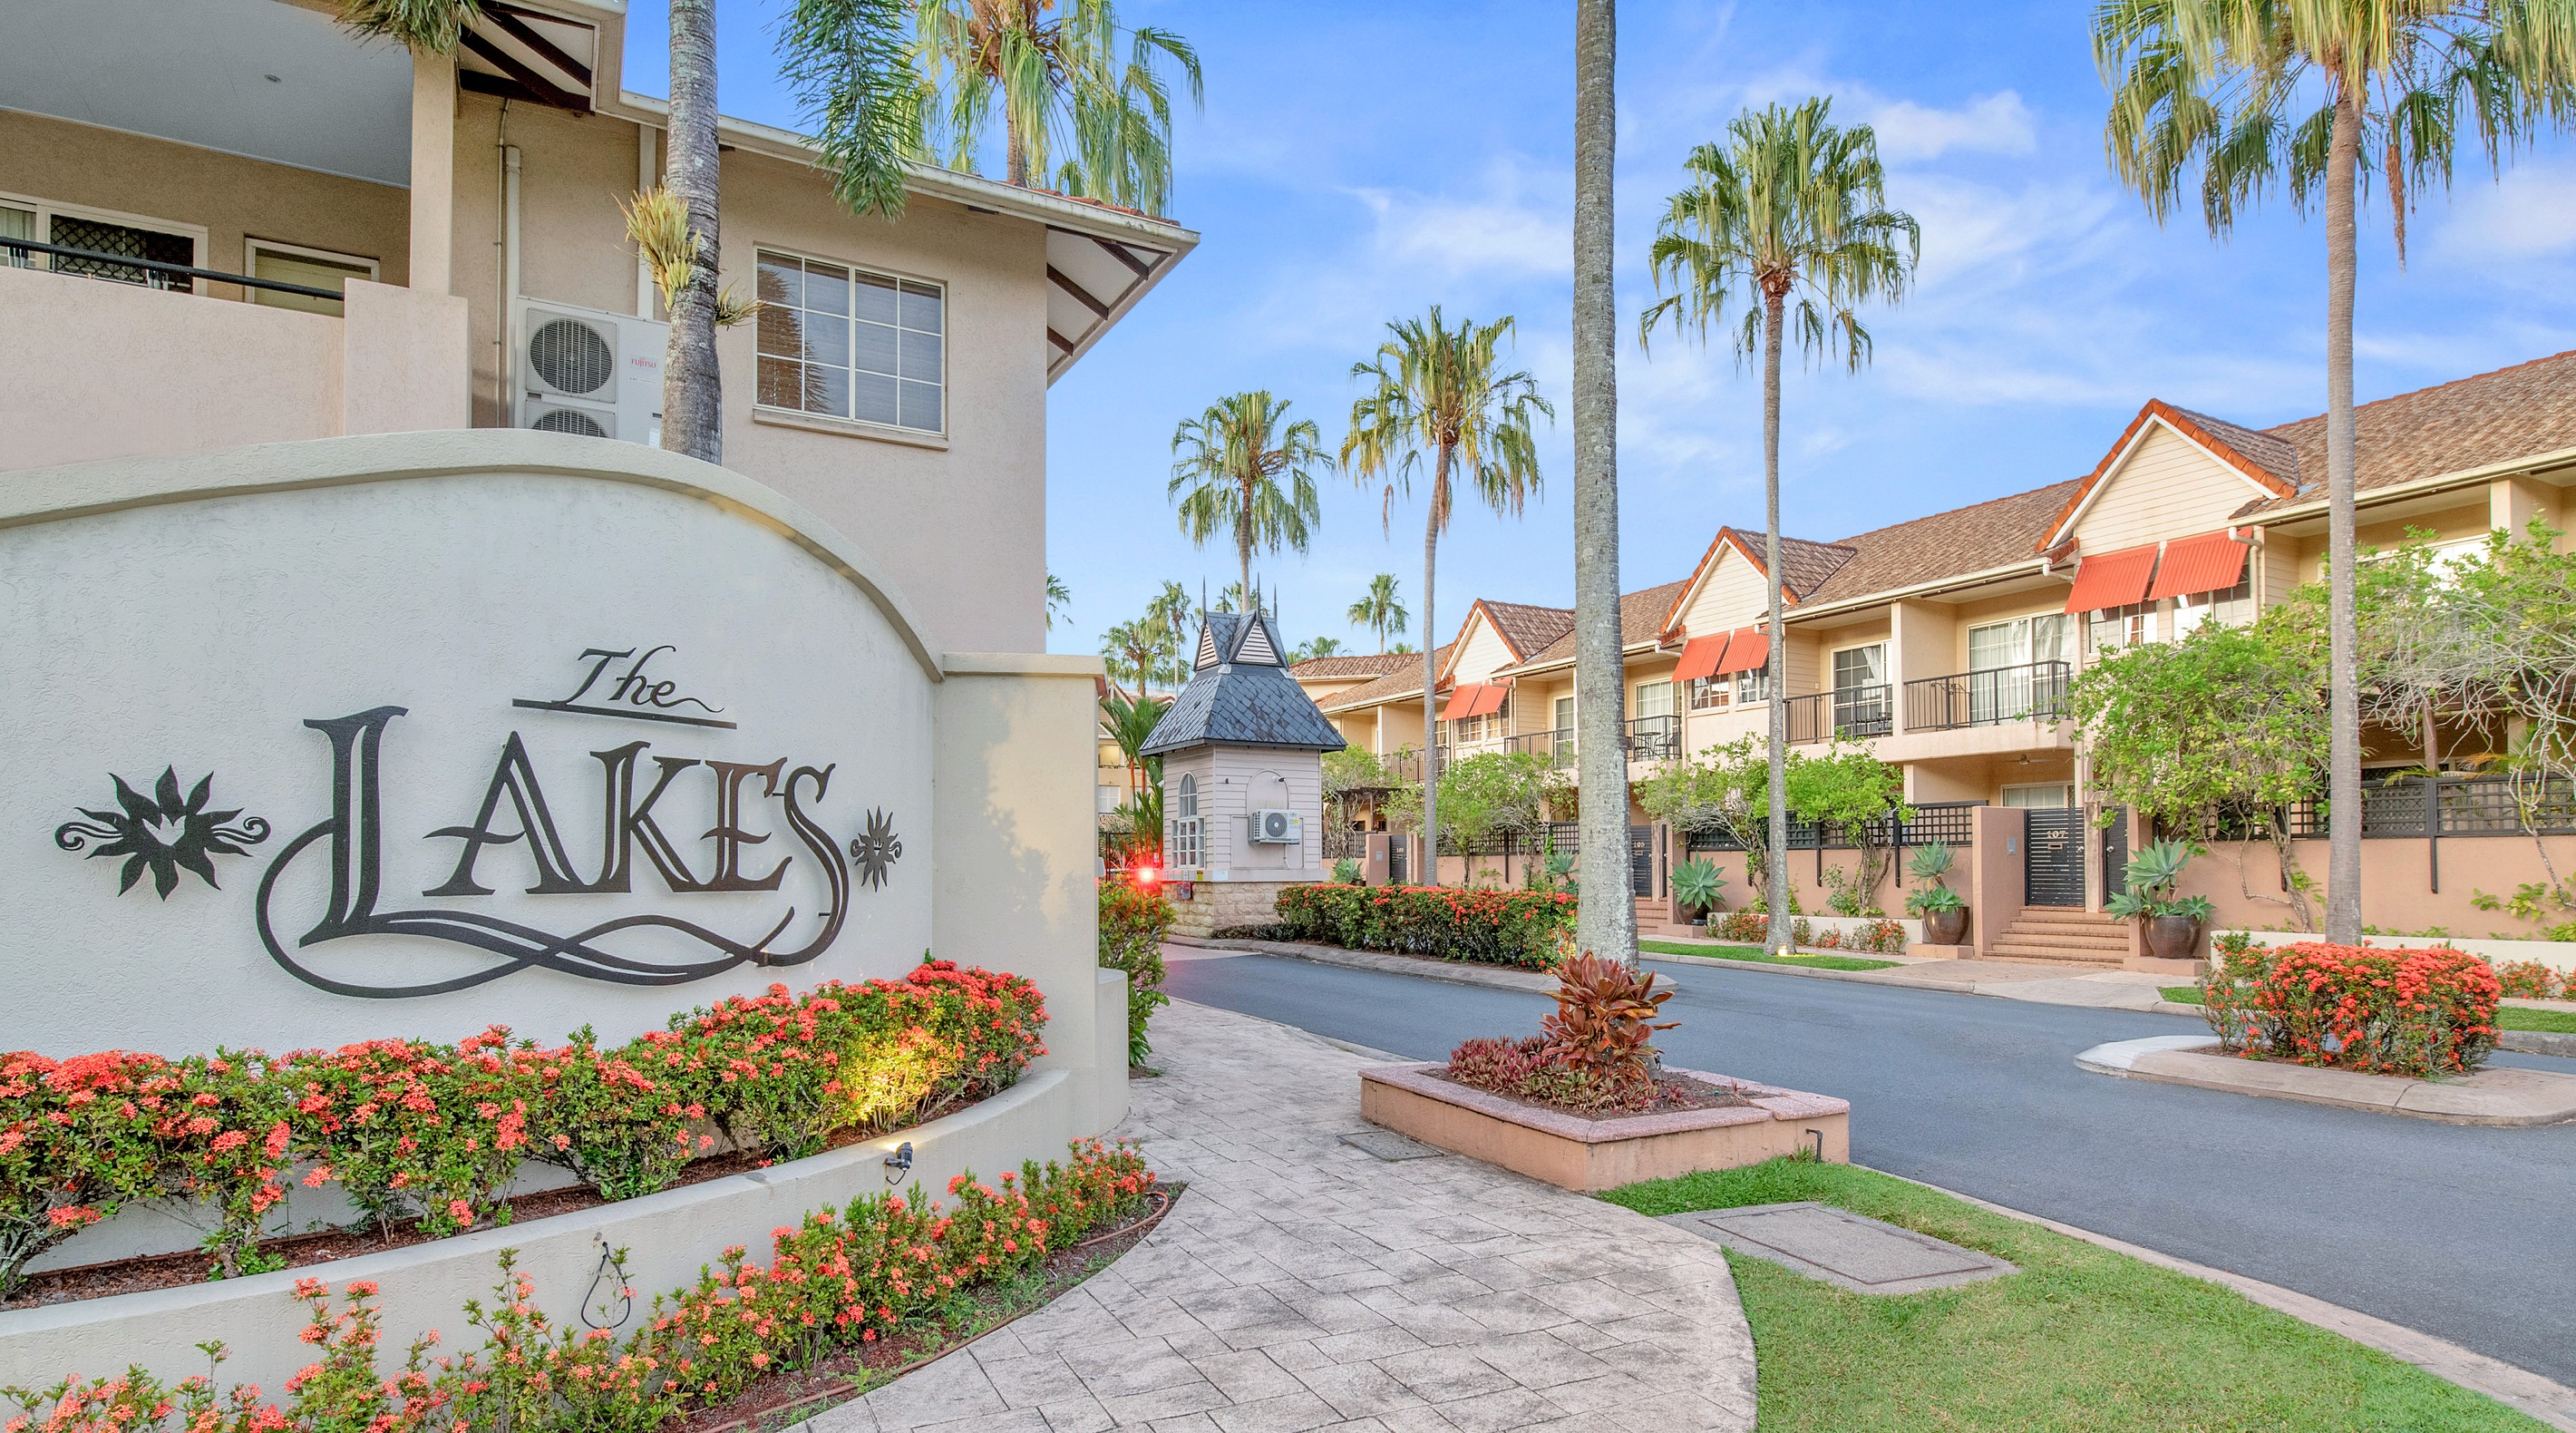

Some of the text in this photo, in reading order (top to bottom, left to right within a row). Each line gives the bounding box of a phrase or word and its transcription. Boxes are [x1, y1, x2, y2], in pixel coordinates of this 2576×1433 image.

[631, 358, 656, 368] FUJITSU
[551, 645, 725, 714] The
[257, 706, 849, 999] LAKES
[2046, 830, 2066, 839] 107
